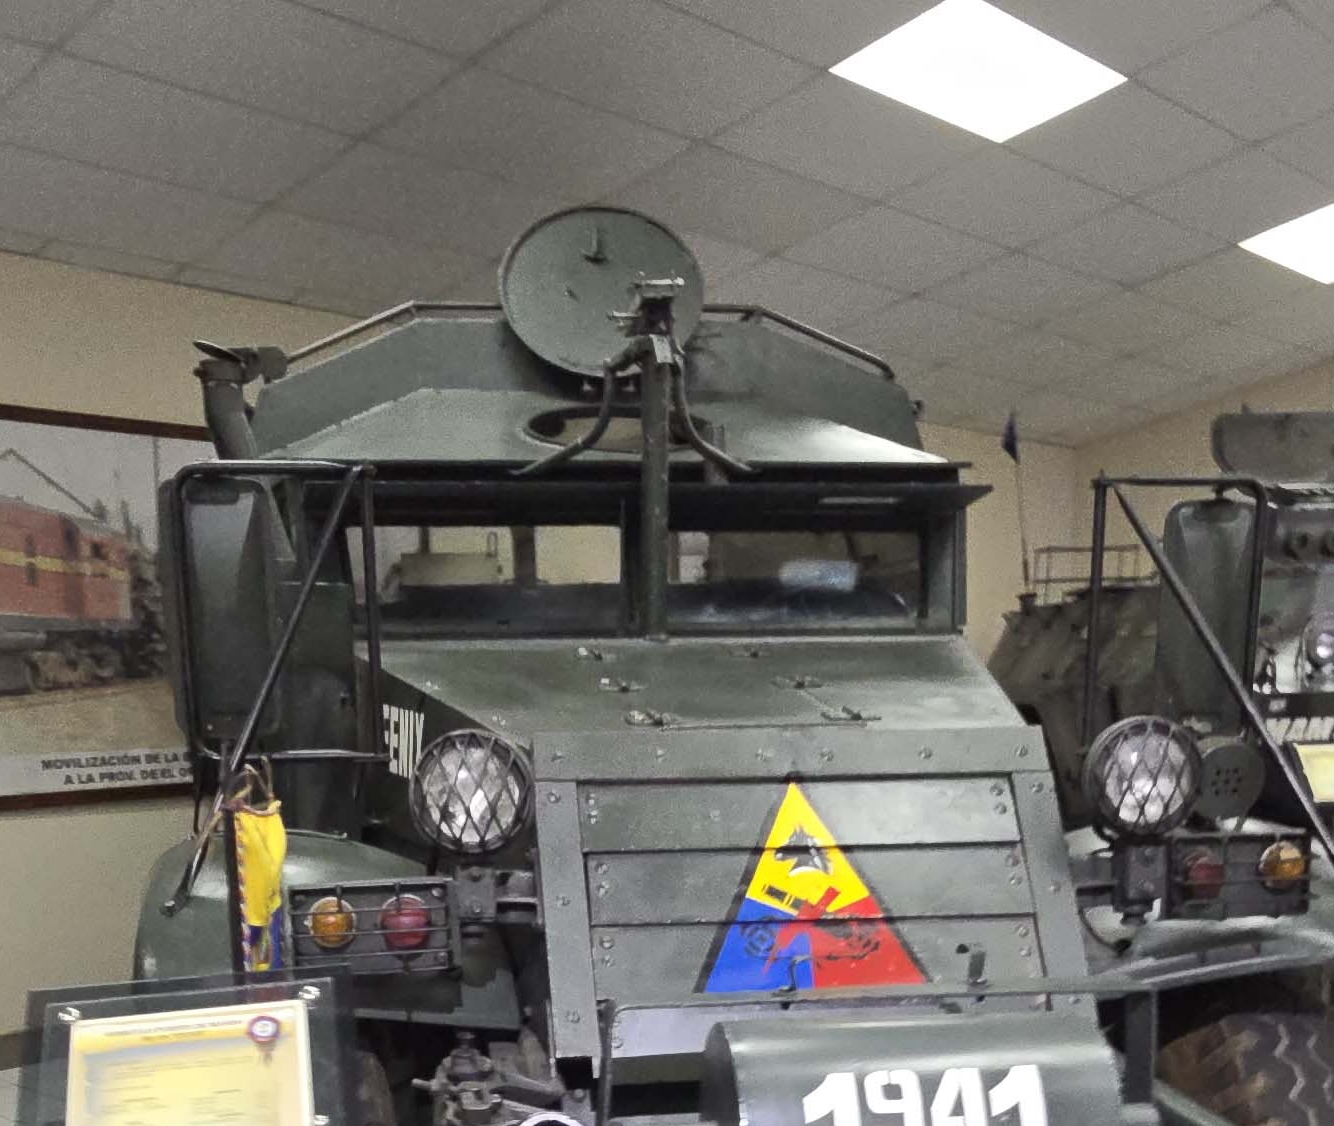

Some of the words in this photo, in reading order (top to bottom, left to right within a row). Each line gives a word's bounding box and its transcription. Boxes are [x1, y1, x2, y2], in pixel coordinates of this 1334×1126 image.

[144, 753, 161, 764] DE
[164, 752, 179, 763] LA
[64, 775, 75, 785] A
[77, 773, 95, 785] LA
[140, 769, 158, 780] DE
